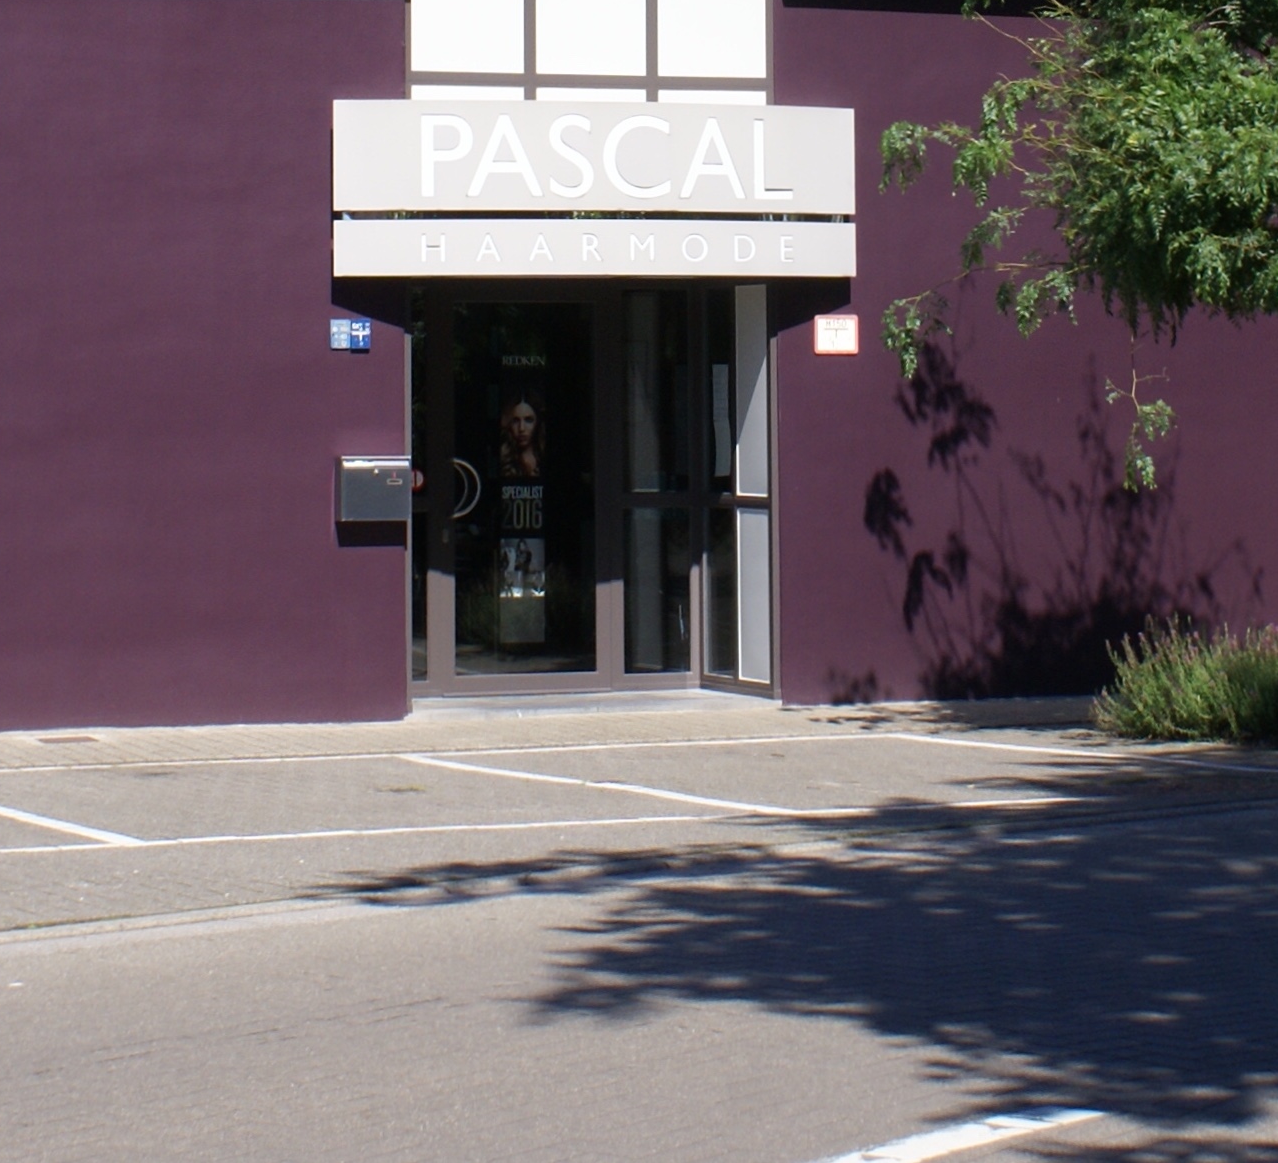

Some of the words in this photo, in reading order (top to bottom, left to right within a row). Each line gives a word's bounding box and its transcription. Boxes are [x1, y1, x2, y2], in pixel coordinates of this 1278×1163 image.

[420, 114, 794, 200] PASCAL
[420, 234, 794, 263] HAARMODE
[502, 355, 545, 366] REDKEN
[502, 486, 544, 499] SPECIALIST
[502, 500, 543, 530] 2016
